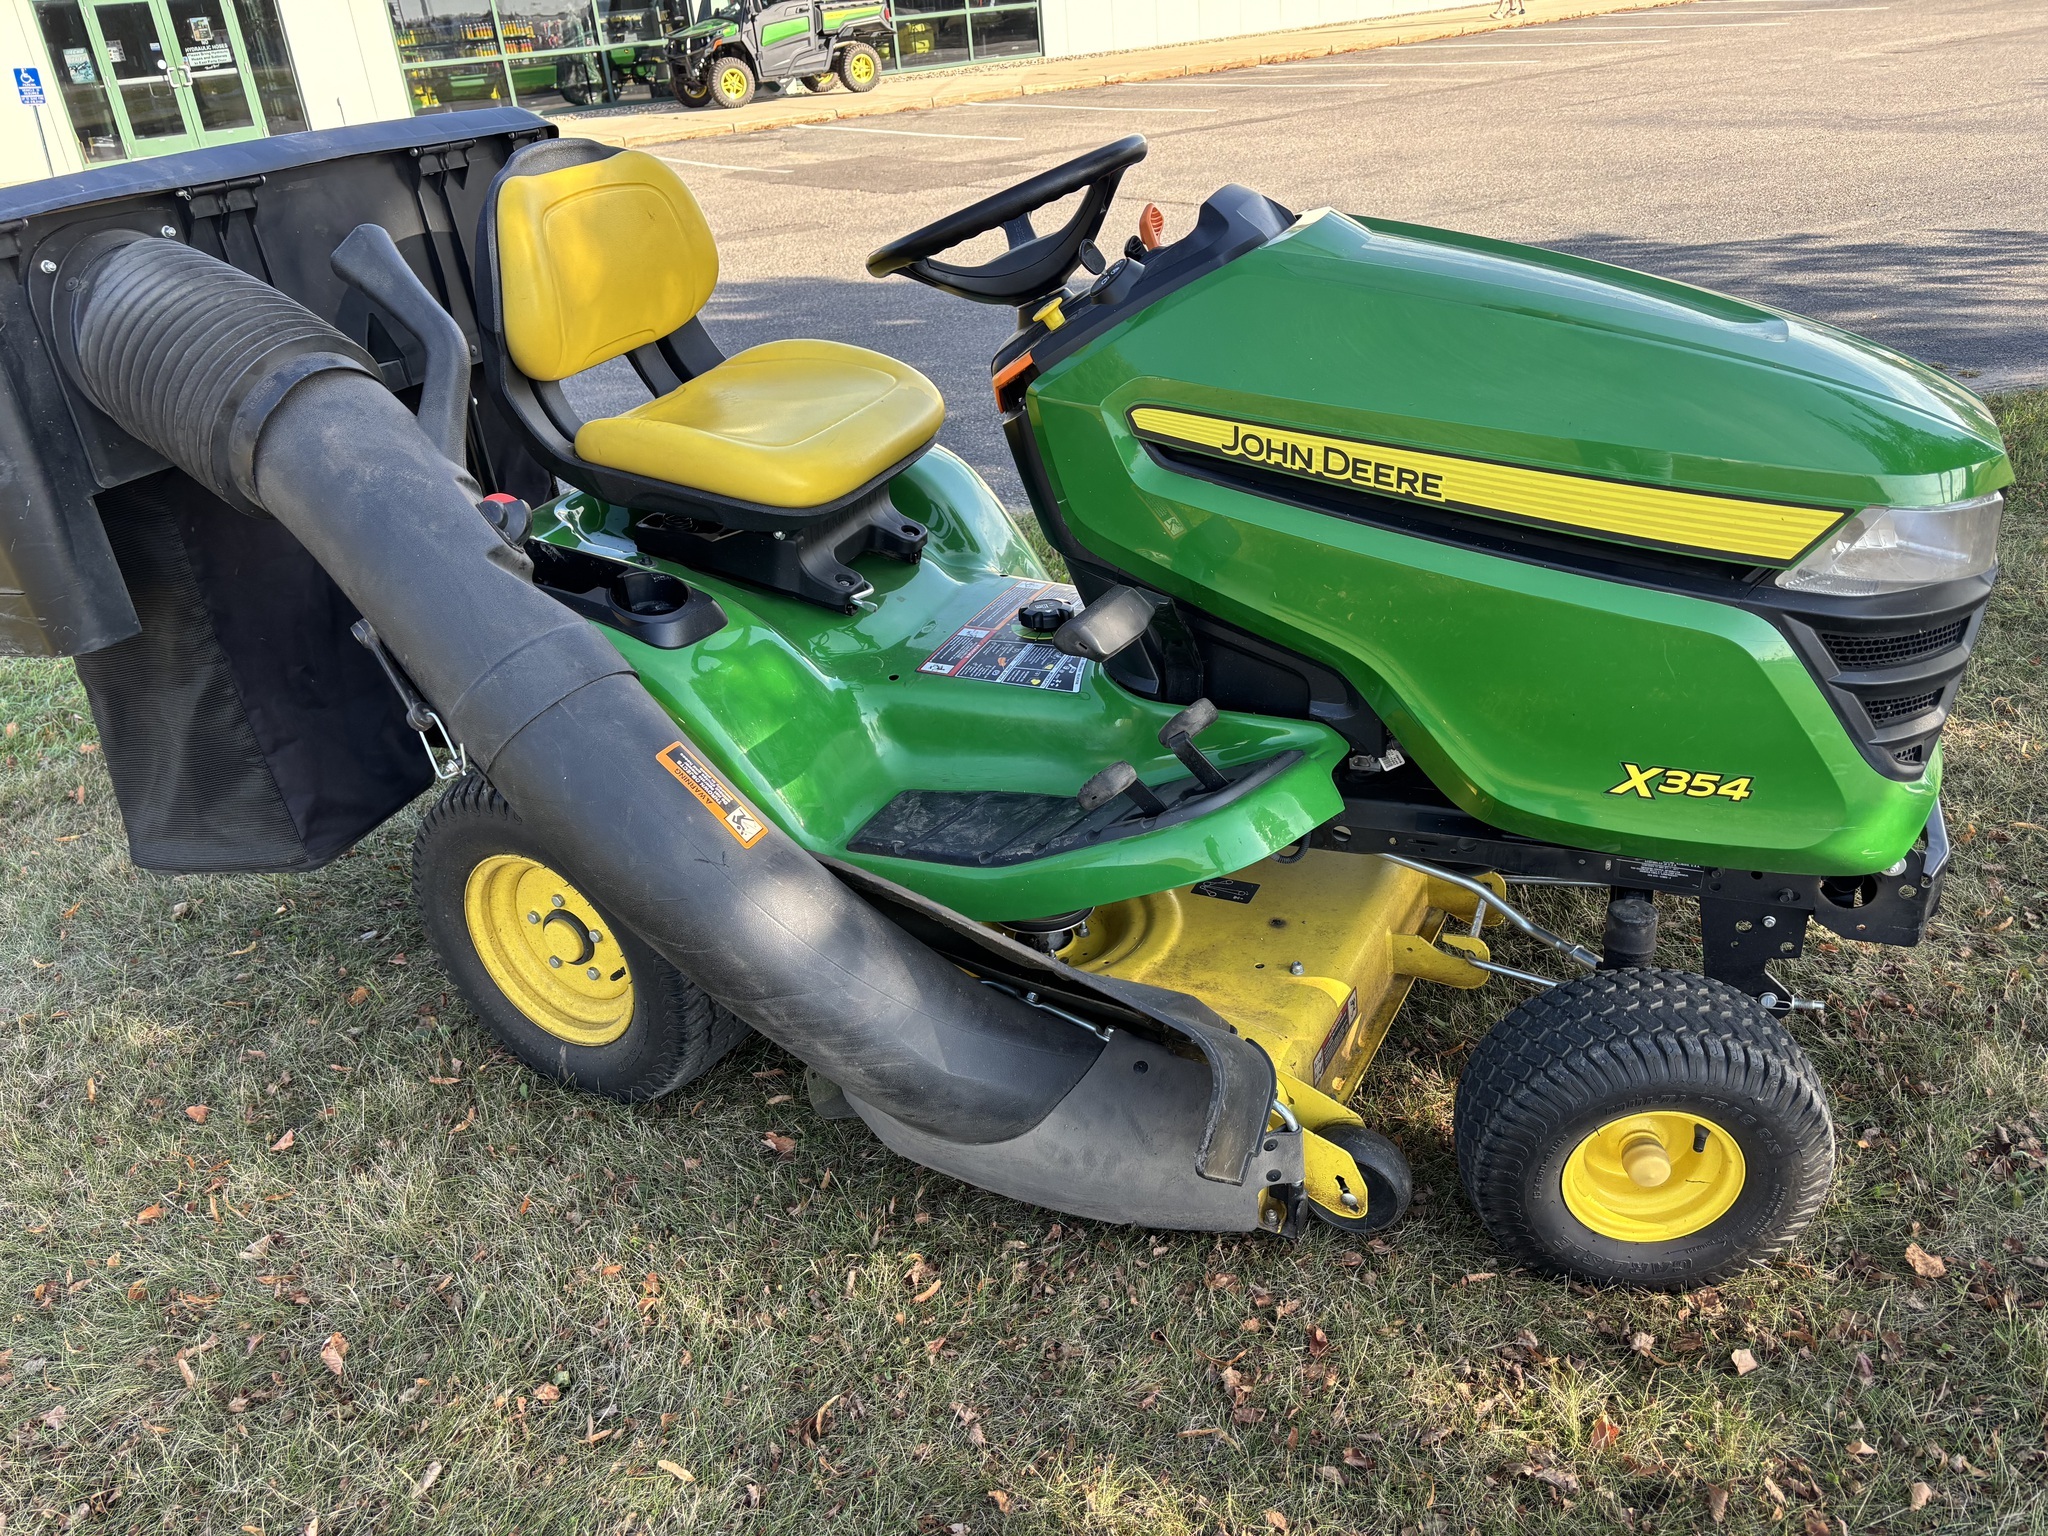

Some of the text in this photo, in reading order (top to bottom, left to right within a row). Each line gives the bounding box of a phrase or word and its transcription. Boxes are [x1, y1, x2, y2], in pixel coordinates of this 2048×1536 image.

[1222, 426, 1443, 498] JOHN DEERE
[674, 768, 706, 800] WARNING
[677, 760, 722, 805] THROWN OBJECTS
[1606, 763, 1754, 802] X354
[1605, 1094, 1687, 1116] MULTI
[1553, 1234, 1693, 1275] CARLISLE
